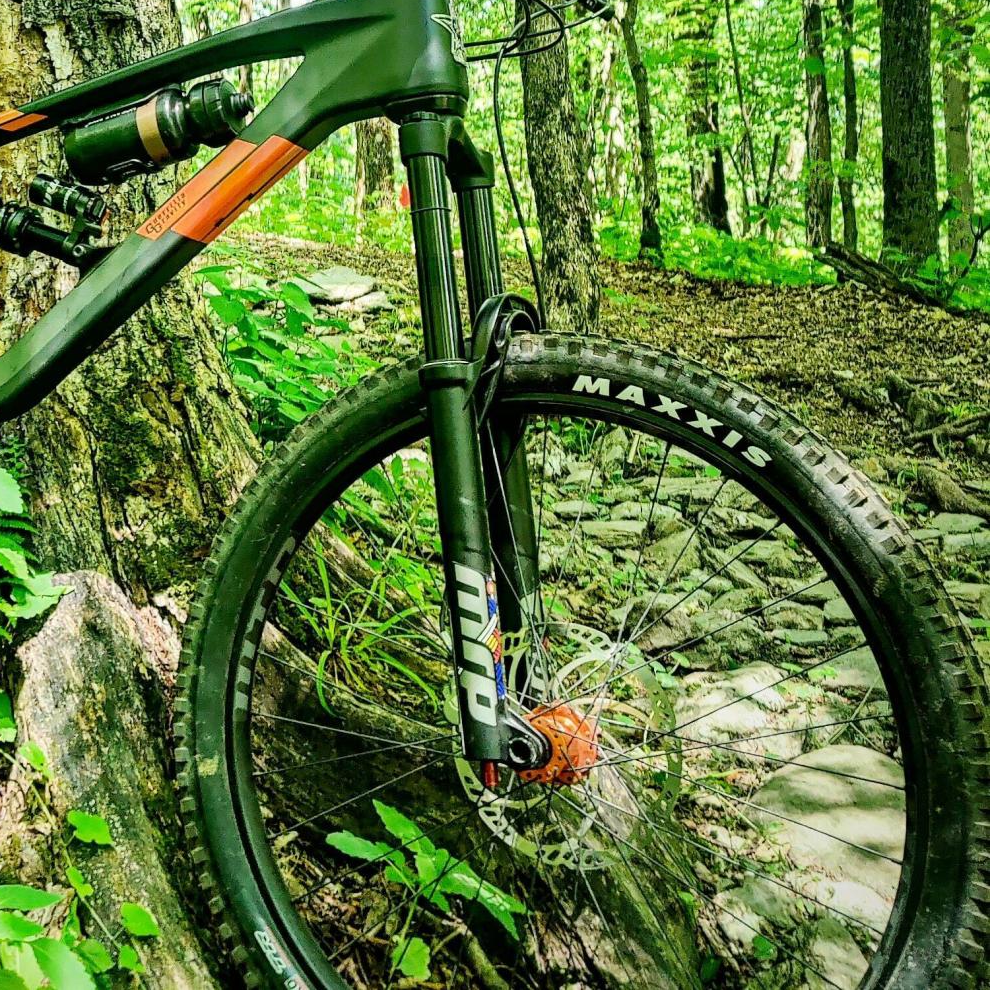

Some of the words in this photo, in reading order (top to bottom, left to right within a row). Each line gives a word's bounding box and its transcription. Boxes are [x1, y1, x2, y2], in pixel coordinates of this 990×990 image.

[145, 192, 186, 234] Guerrilla
[571, 374, 773, 468] MAXXIS
[454, 562, 497, 726] mrp
